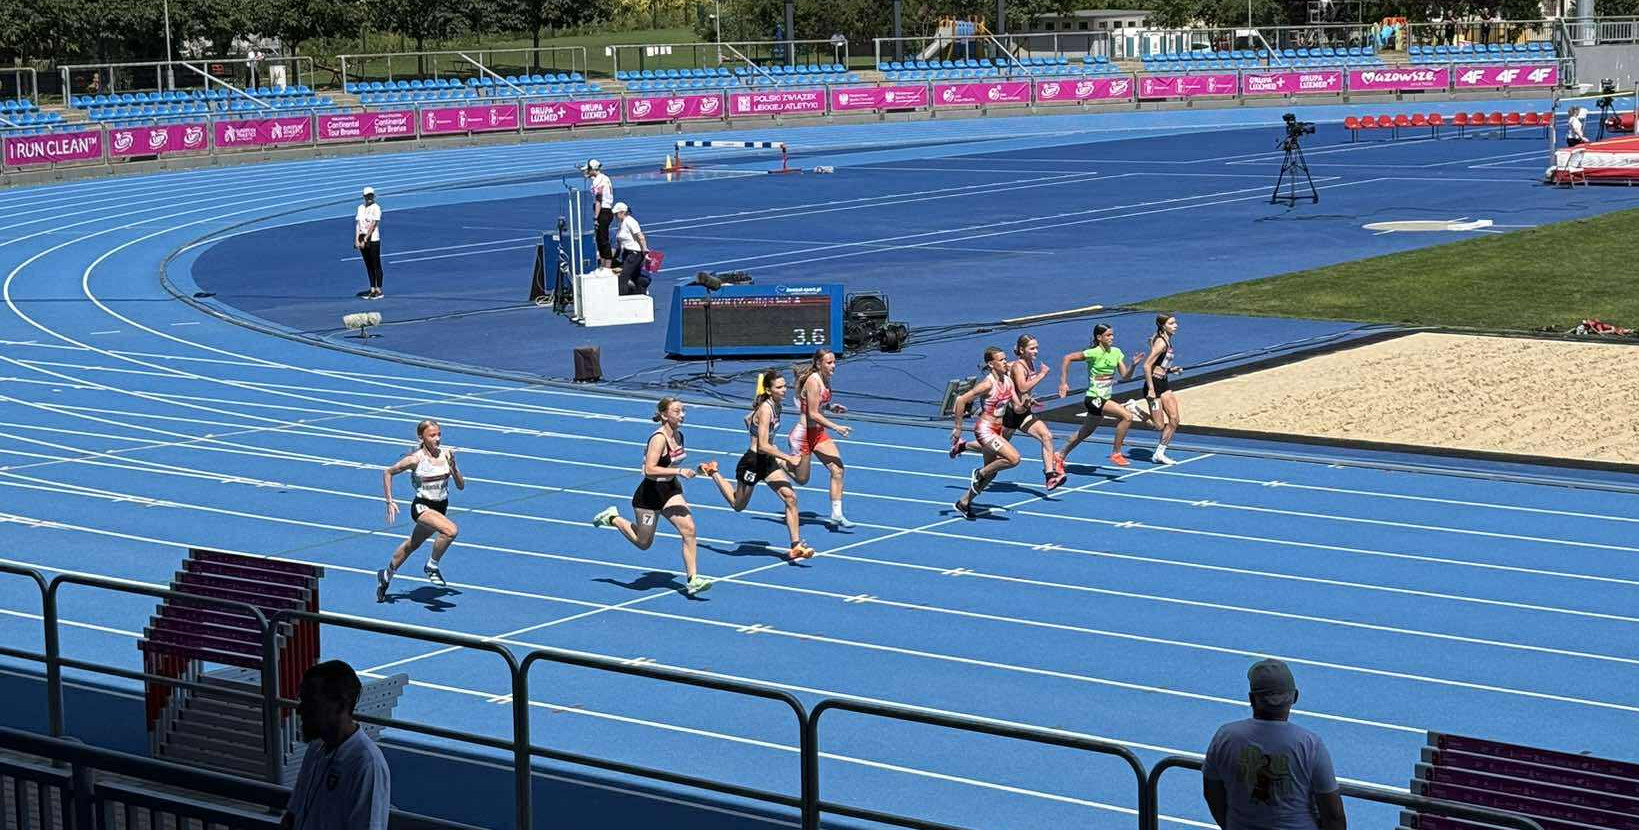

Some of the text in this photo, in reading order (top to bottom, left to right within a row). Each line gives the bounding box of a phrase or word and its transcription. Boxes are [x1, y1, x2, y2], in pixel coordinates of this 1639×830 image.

[1461, 70, 1485, 83] 4F
[1495, 69, 1520, 83] 4F
[1527, 68, 1552, 82] 4F
[1249, 82, 1277, 90] LUXMED
[1299, 81, 1328, 89] LUXMED
[753, 94, 817, 103] POLSKI ZWIĄZEK
[581, 104, 603, 112] GRUPA
[753, 103, 782, 111] LEKKIEJ
[784, 102, 818, 110] ATLETYKI
[530, 113, 558, 122] LUXMED
[581, 111, 607, 120] LUXMED
[327, 120, 360, 129] Continental
[374, 117, 407, 126] Continental
[375, 126, 387, 134] Tour
[10, 144, 15, 158] I
[17, 142, 44, 157] RUN
[793, 329, 826, 346] 3.6
[644, 514, 652, 524] 7
